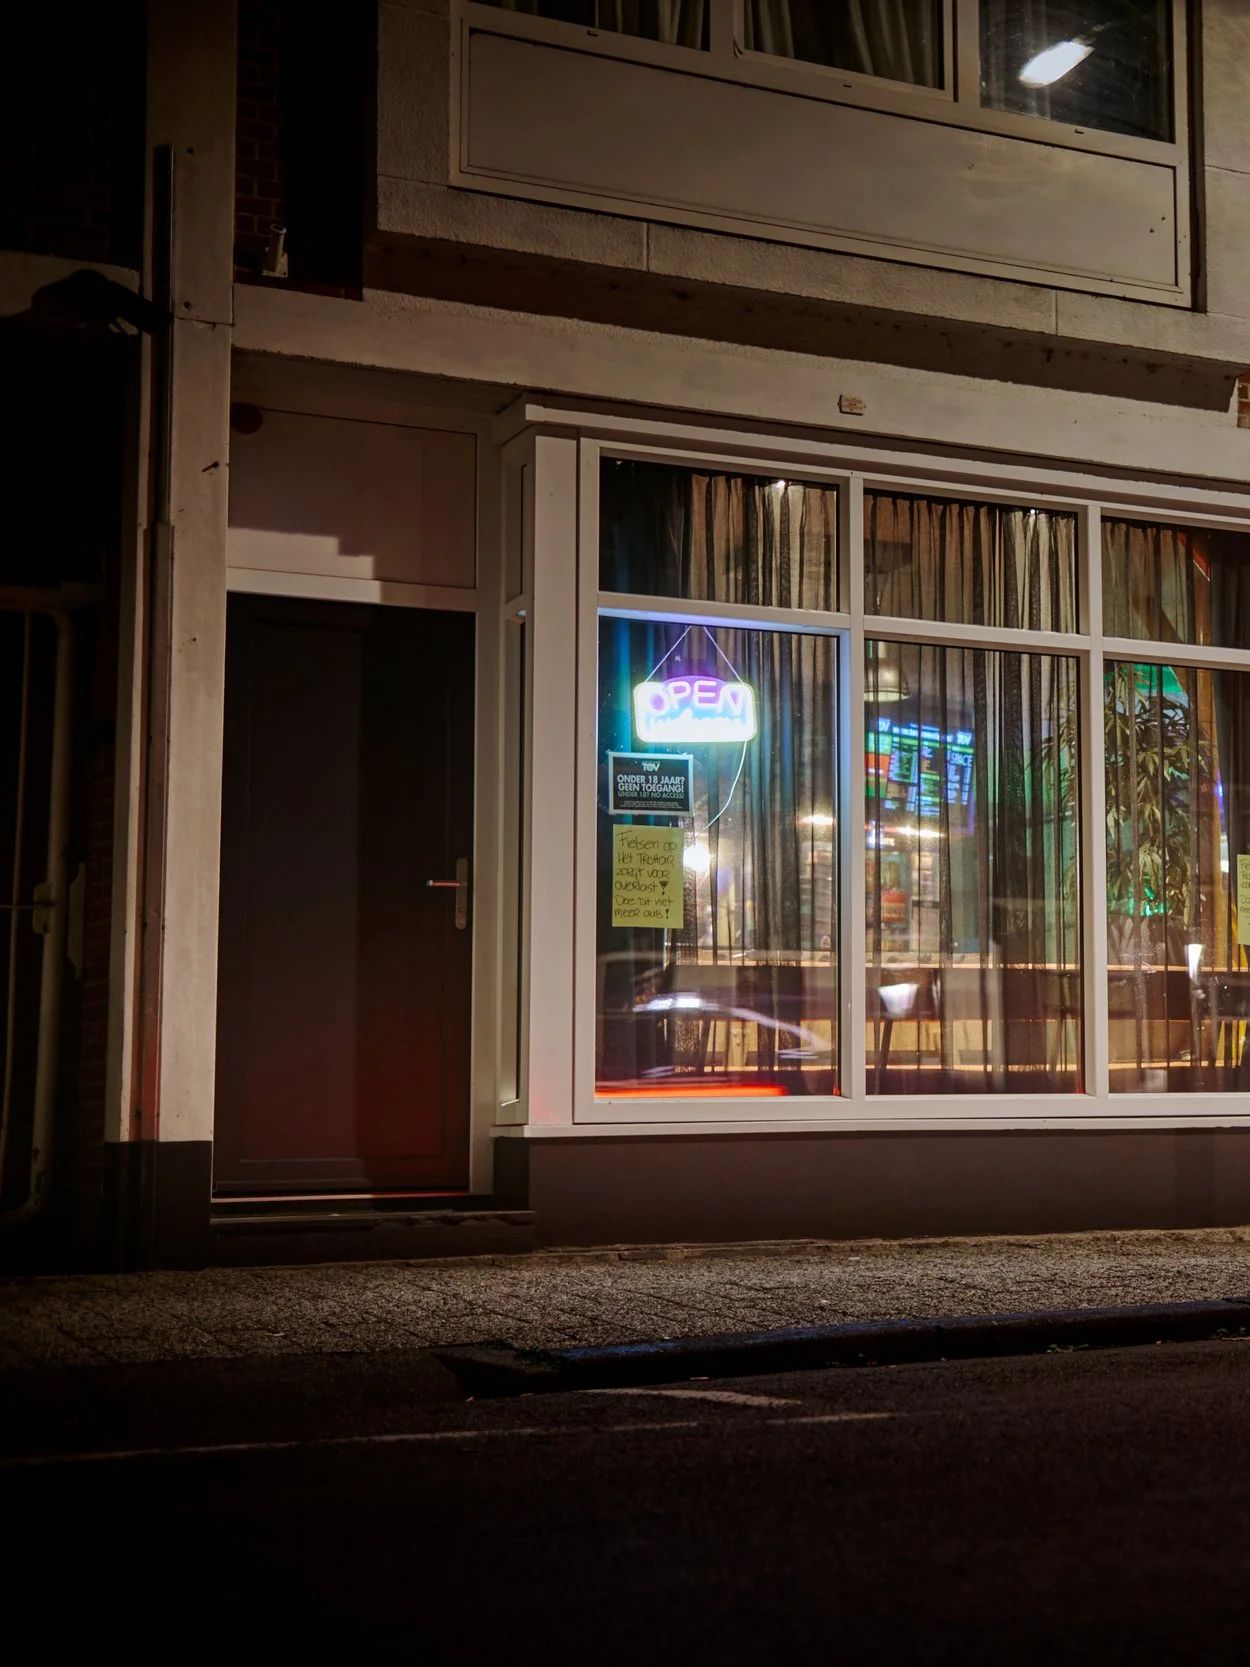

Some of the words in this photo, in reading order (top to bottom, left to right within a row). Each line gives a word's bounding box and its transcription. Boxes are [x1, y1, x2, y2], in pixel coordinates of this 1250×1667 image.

[646, 680, 748, 718] OPEN
[642, 762, 660, 772] TOV
[617, 774, 646, 784] ONDER
[649, 776, 658, 784] 18
[660, 776, 685, 785] JAAR?
[618, 783, 640, 792] GEEN
[641, 784, 684, 793] TOEGANG!
[616, 830, 659, 850] Fietsen
[663, 842, 677, 853] op
[614, 895, 636, 906] Doe
